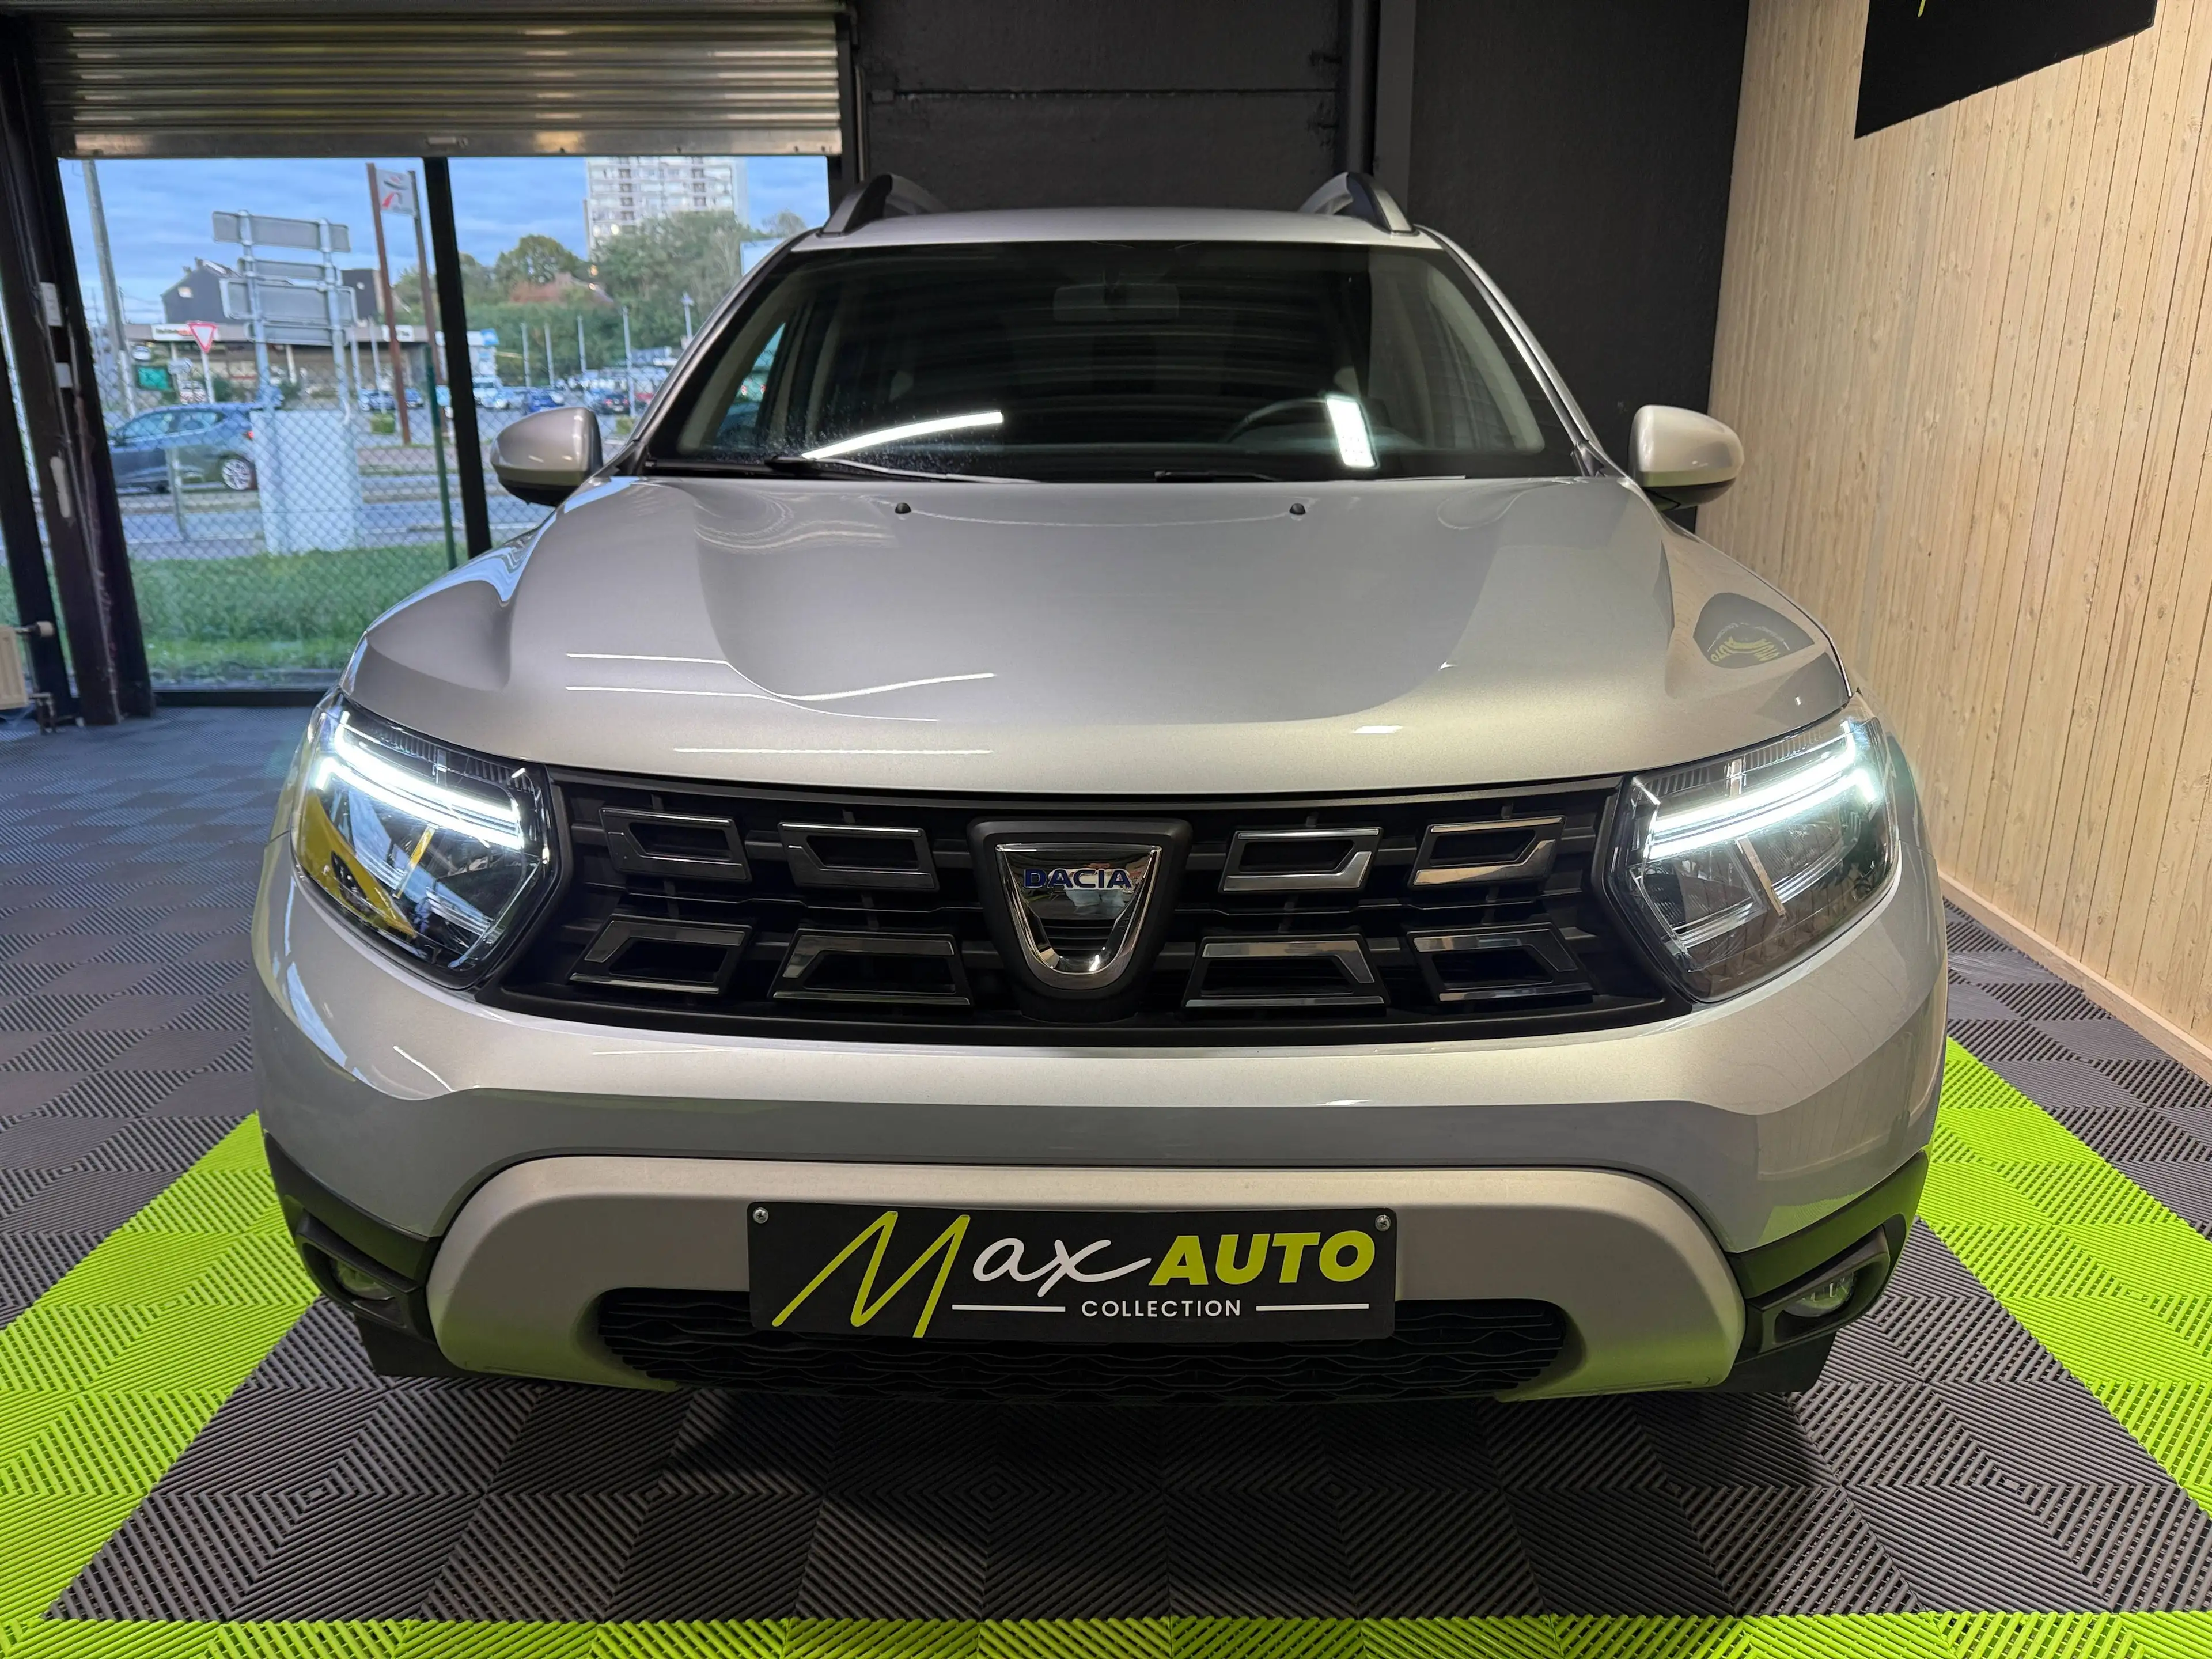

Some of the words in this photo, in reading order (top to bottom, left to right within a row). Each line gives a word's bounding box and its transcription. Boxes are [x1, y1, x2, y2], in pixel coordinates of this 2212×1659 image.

[1024, 869, 1134, 889] DACIA
[772, 1211, 1152, 1338] Max
[1149, 1230, 1376, 1286] AUTO
[1081, 1300, 1241, 1317] COLLECTION
